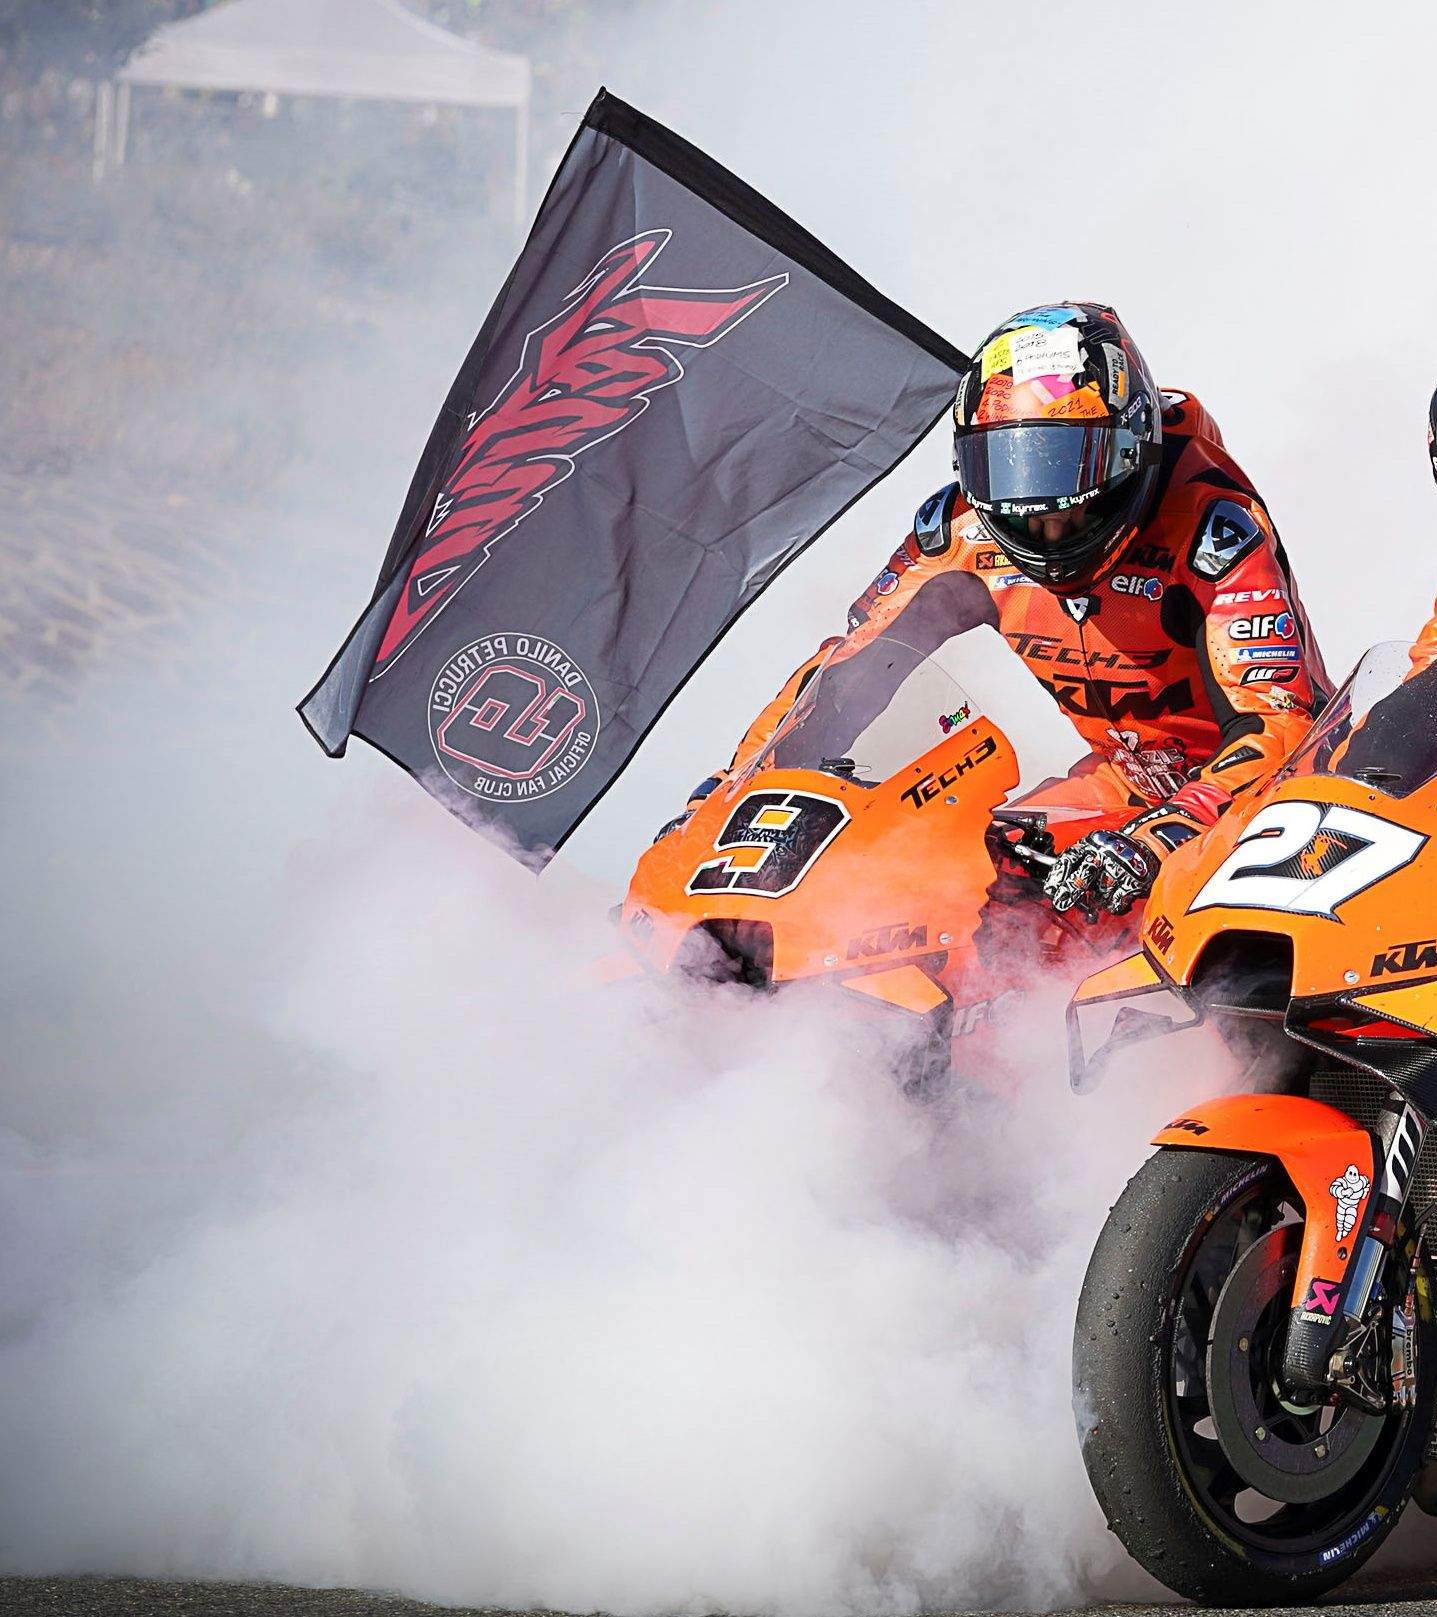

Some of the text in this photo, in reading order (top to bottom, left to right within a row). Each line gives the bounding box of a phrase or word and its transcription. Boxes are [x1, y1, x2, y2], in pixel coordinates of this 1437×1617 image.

[1047, 398, 1084, 418] 2021
[1111, 574, 1145, 595] elf
[1229, 615, 1275, 639] elf
[1251, 650, 1296, 659] MICHELIN
[900, 735, 998, 810] TECH3
[684, 788, 853, 899] 9
[1185, 800, 1431, 926] 27
[847, 922, 928, 961] KTM
[1148, 914, 1176, 956] KTM
[1405, 1329, 1413, 1376] brembo
[1323, 1522, 1370, 1561] MICHELIN
